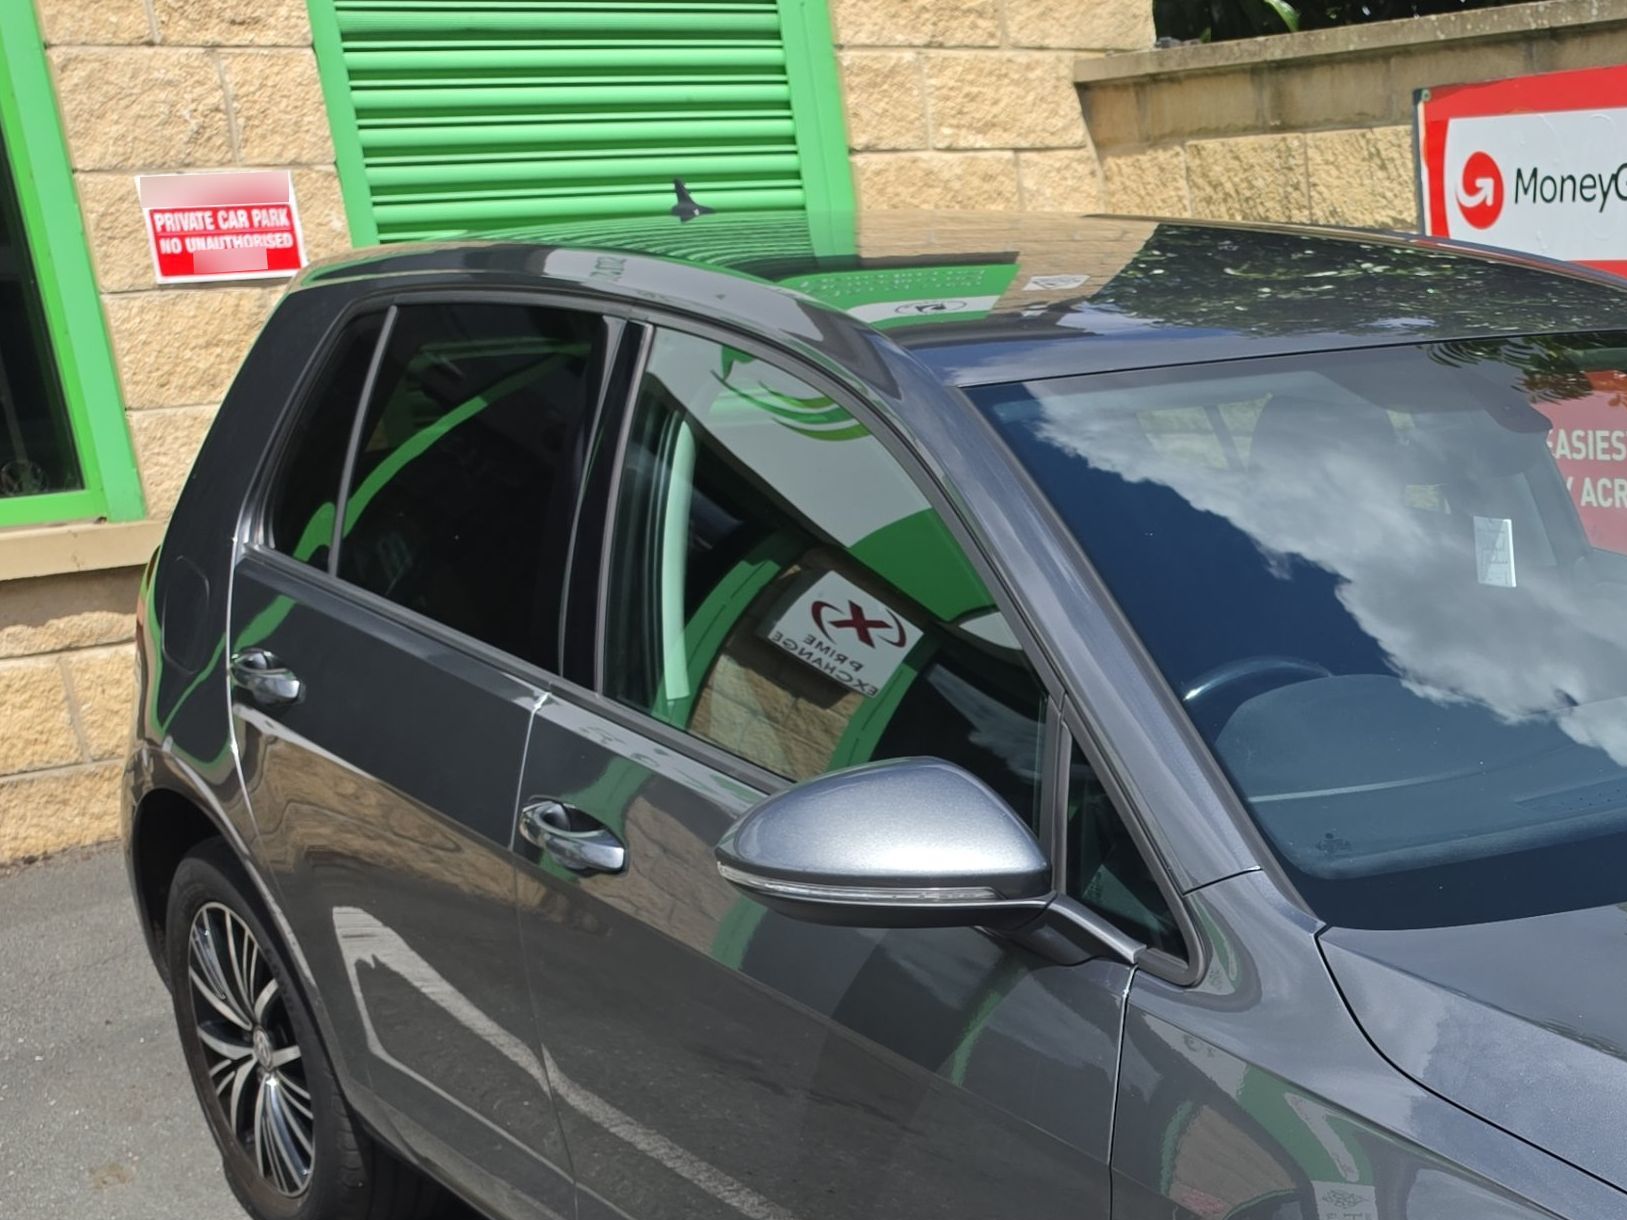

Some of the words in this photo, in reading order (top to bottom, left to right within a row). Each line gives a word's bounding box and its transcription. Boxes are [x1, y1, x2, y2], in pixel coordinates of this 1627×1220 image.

[153, 210, 215, 232] PRIVATE
[217, 209, 250, 231] CAR
[251, 207, 291, 228] PARK
[159, 237, 182, 255] NO
[184, 232, 294, 253] UNAUTHORISED
